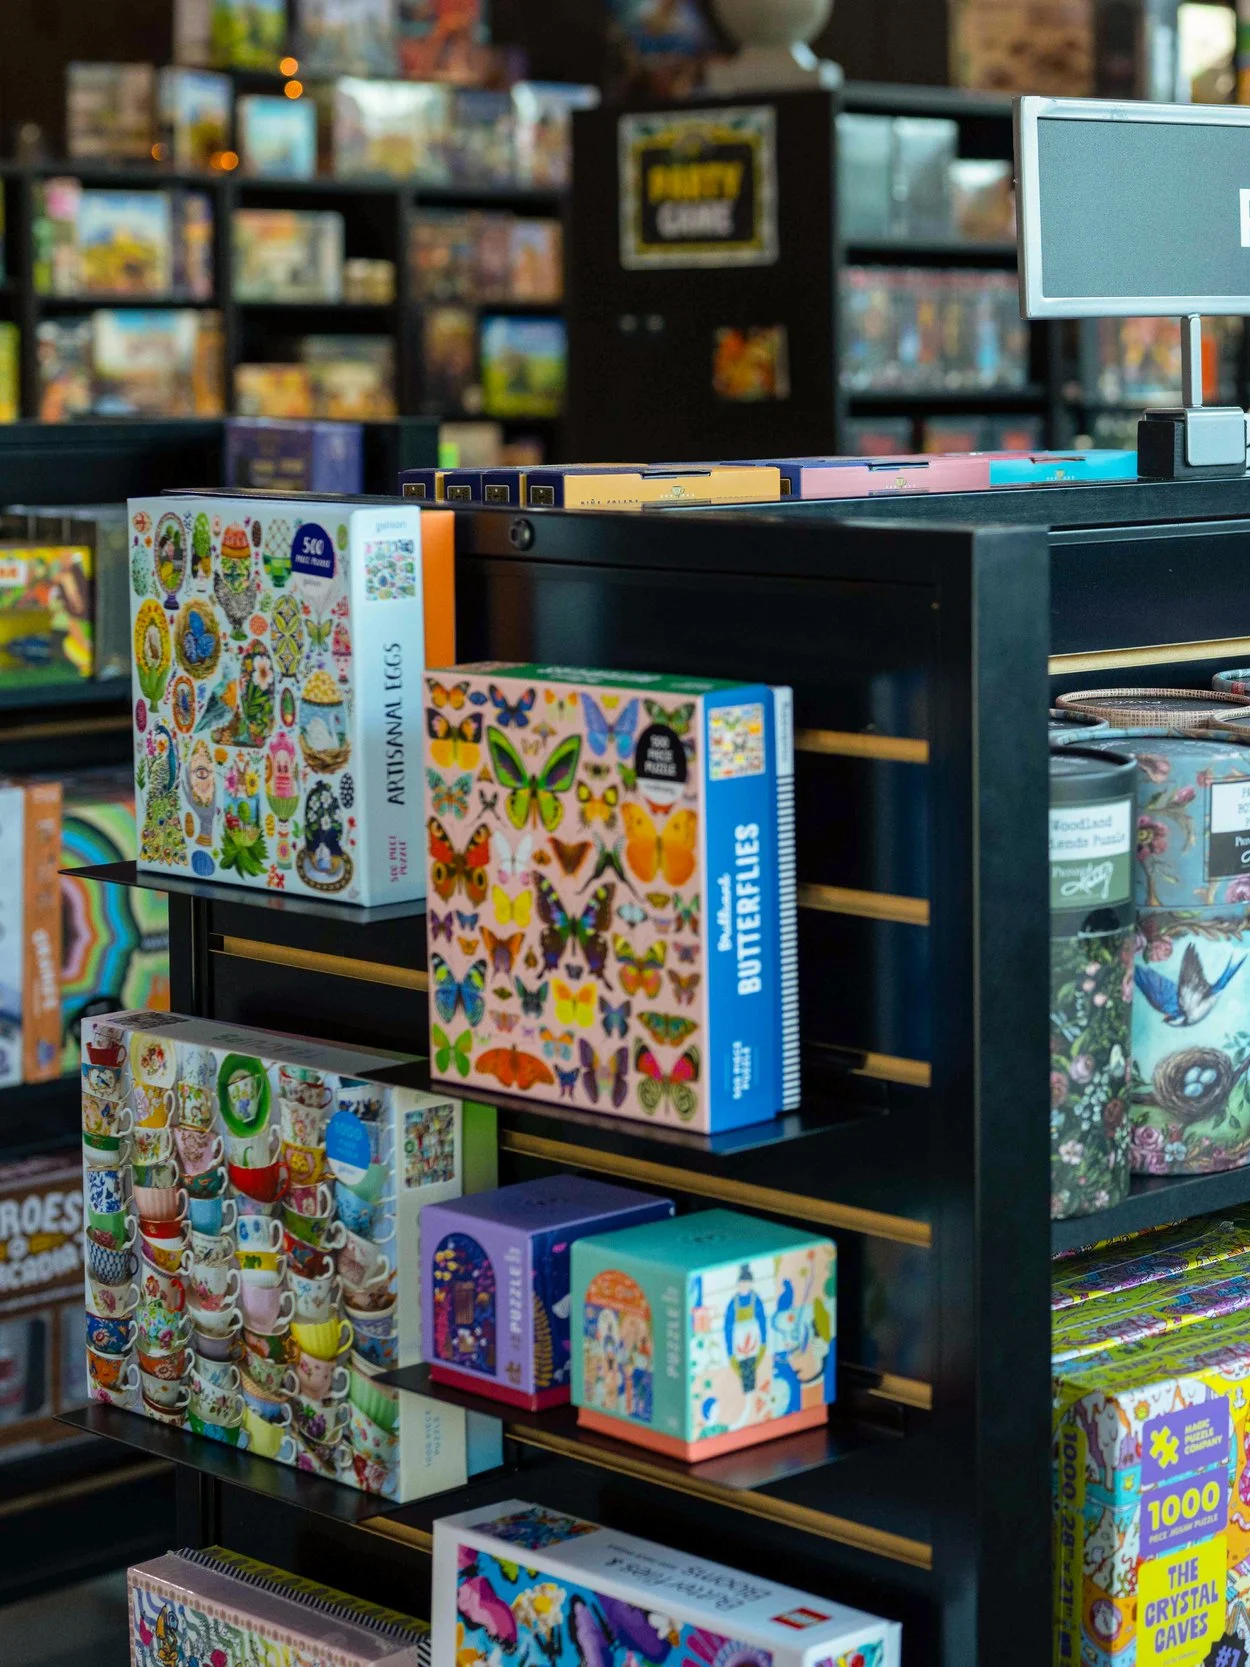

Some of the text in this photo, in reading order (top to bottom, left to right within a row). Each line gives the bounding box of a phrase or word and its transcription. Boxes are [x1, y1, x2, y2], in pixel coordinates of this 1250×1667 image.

[302, 536, 325, 555] 500
[384, 643, 406, 806] ARTISANAL EGGS
[735, 823, 762, 996] BUTTERFLIES
[509, 1265, 522, 1334] PUZZLE
[666, 1311, 680, 1379] PUZZLE
[1184, 1418, 1210, 1434] MAGIC
[1184, 1427, 1214, 1445] PUZZLE
[1184, 1435, 1223, 1455] COMPANY
[1063, 1431, 1078, 1501] 1000
[1147, 1481, 1221, 1532] 1000
[1148, 1512, 1219, 1545] PIECE JIGSAW PUZZLE
[1168, 1556, 1199, 1590] THE
[1144, 1579, 1219, 1629] CRYSTAL
[1154, 1611, 1209, 1655] CAVES
